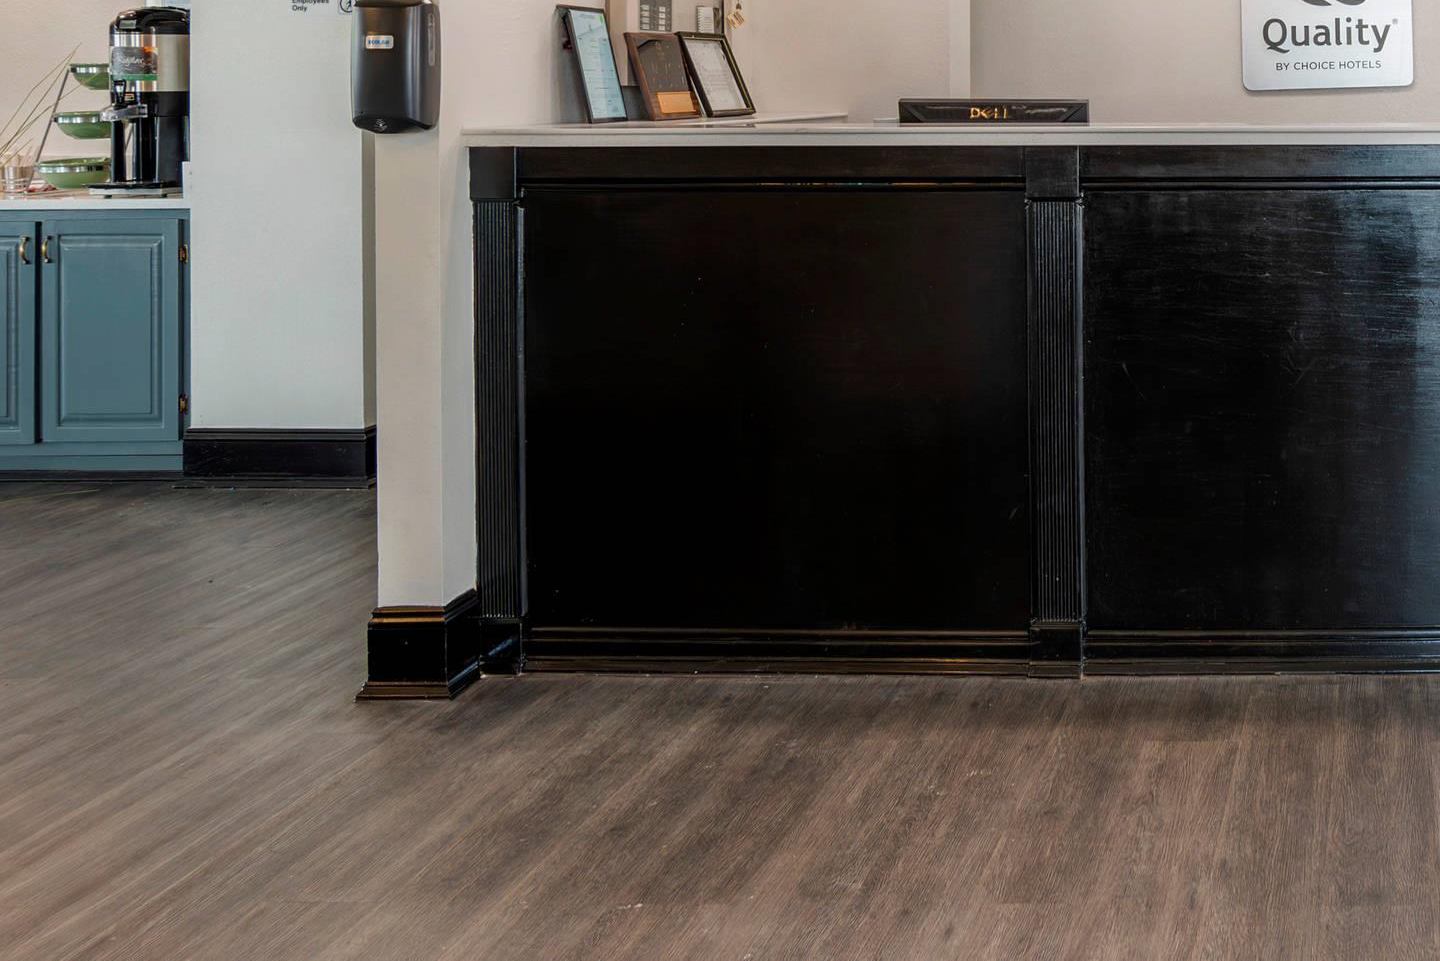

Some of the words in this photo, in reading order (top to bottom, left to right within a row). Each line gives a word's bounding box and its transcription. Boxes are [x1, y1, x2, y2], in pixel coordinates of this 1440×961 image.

[1262, 17, 1391, 53] Quality
[1276, 61, 1290, 71] BY
[1294, 61, 1335, 71] CHOICE
[1339, 60, 1382, 70] HOTELS
